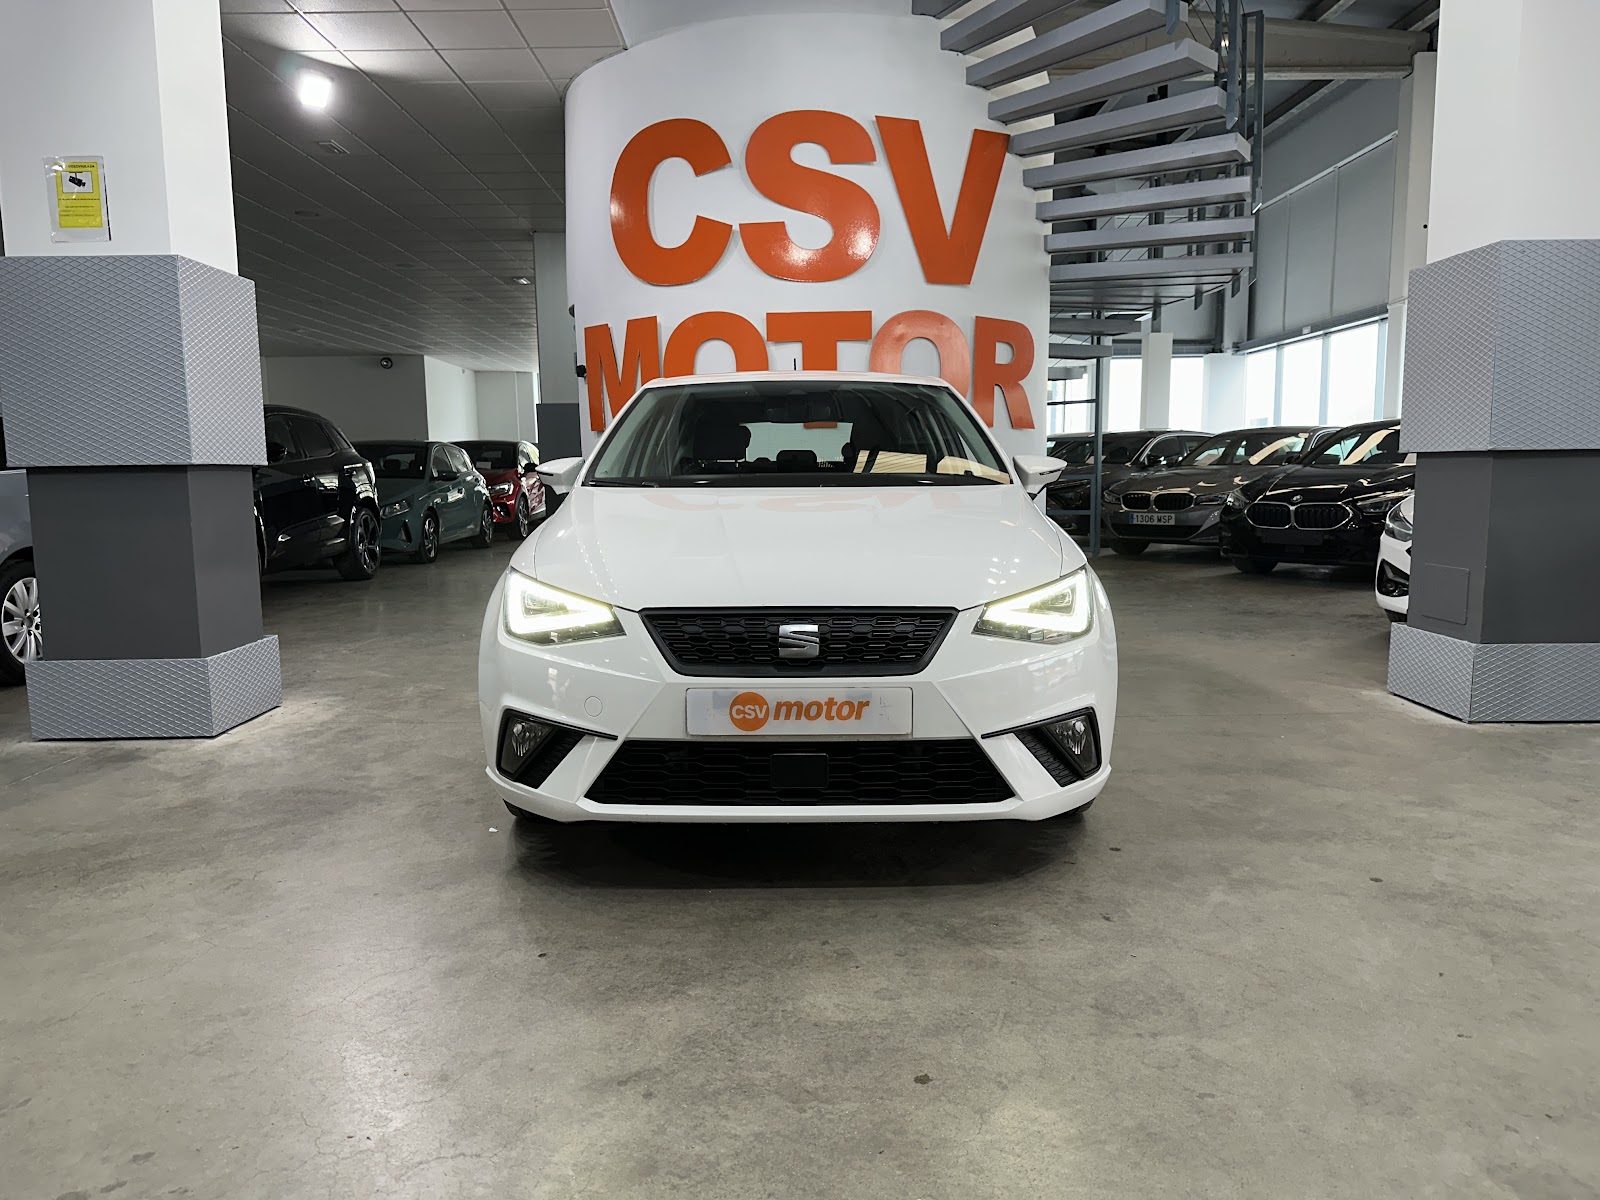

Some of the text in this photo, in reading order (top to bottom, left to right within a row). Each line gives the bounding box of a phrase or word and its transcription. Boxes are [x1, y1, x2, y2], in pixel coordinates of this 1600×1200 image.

[610, 109, 1010, 286] CSV
[1135, 514, 1173, 523] 1306 MSP
[731, 697, 871, 721] CSV motor
